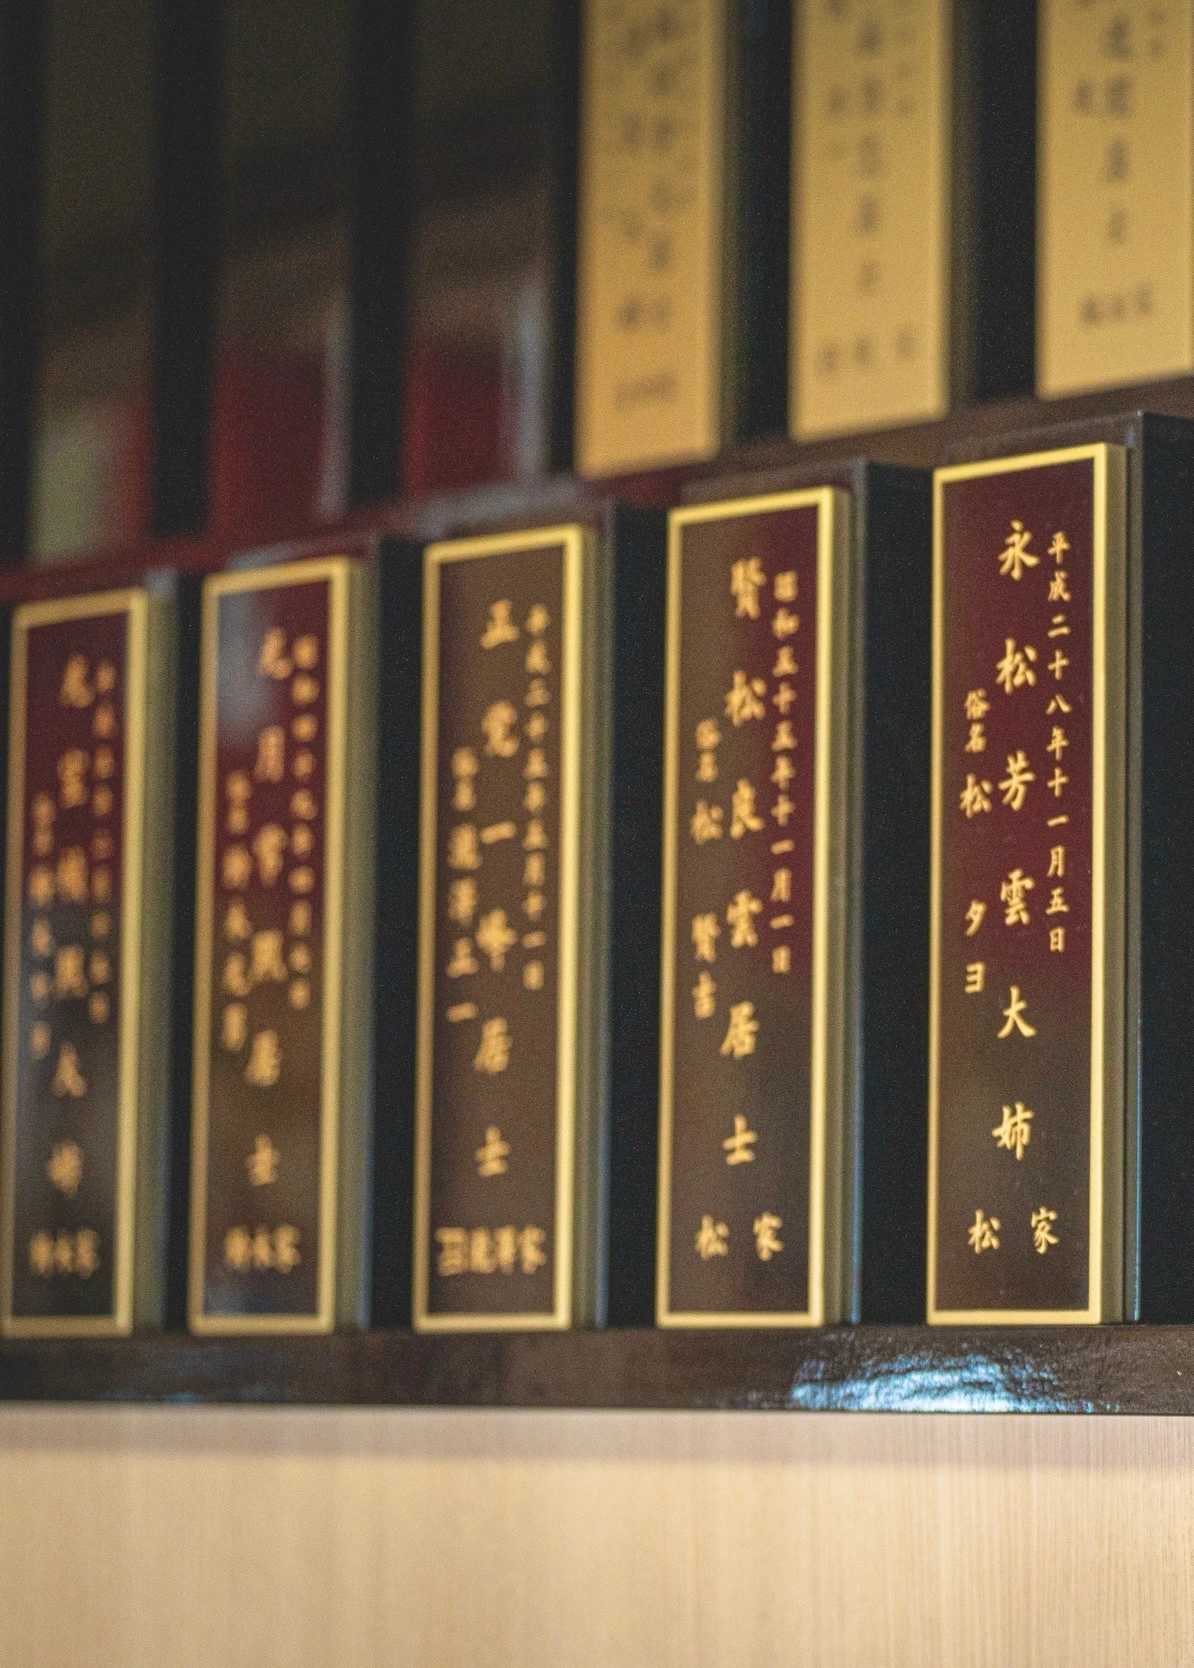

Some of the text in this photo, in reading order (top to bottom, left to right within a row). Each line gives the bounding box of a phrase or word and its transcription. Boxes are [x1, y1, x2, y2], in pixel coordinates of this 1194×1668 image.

[991, 519, 1041, 1161] 永松芳雲大姉
[1045, 530, 1072, 953] 平成二十八年十一月五日
